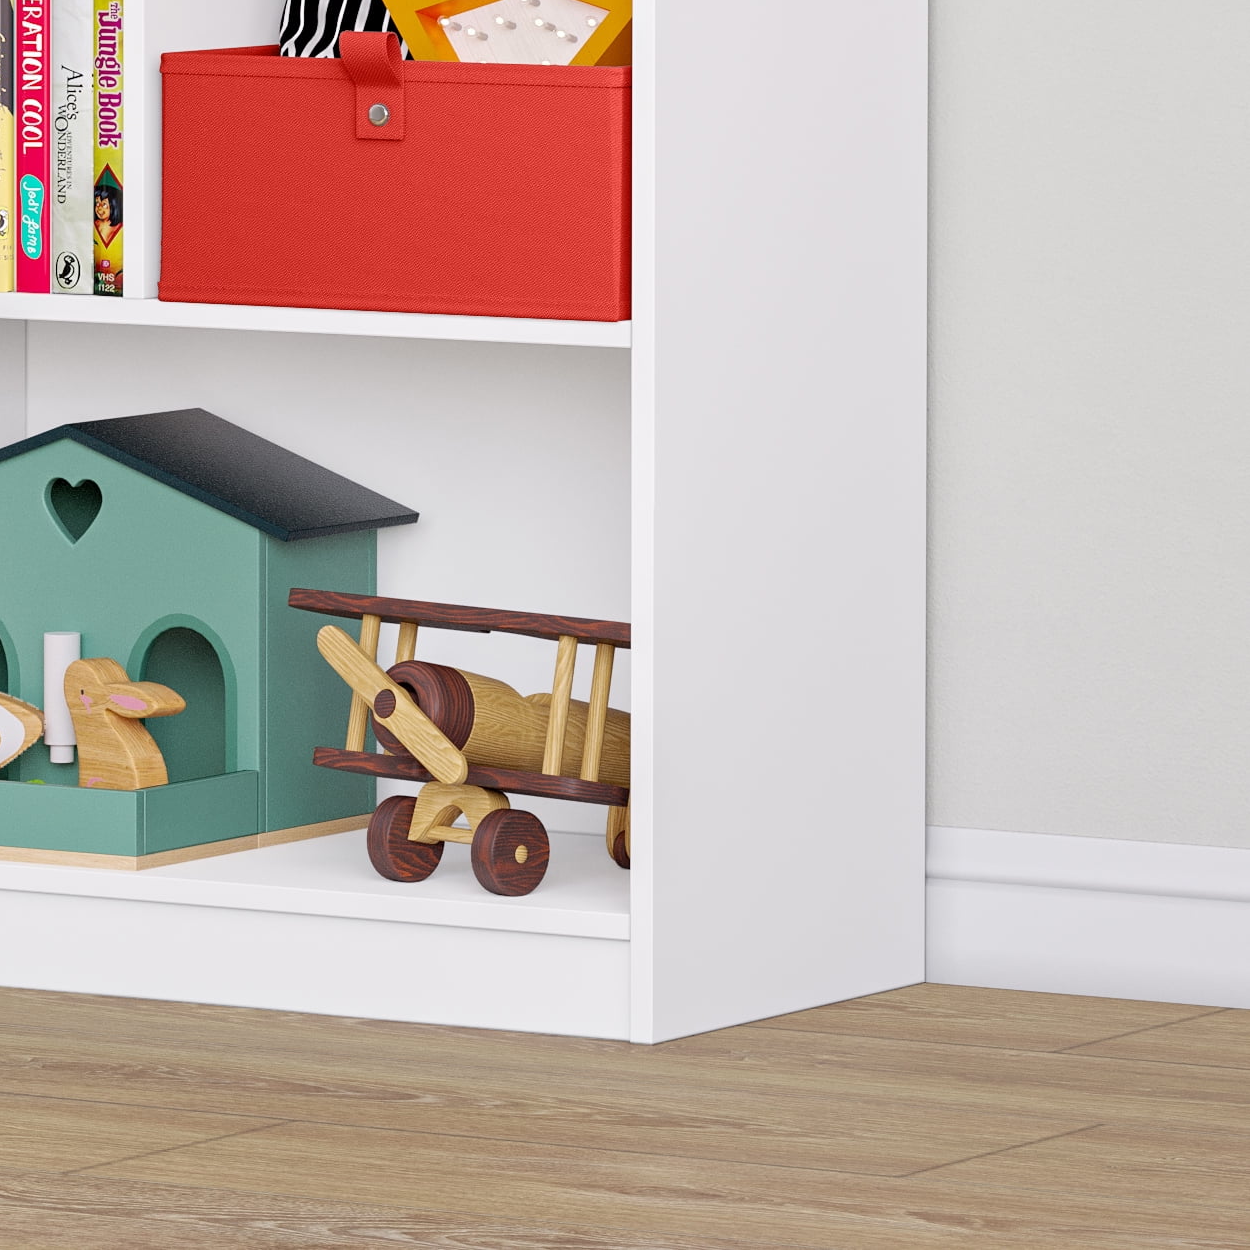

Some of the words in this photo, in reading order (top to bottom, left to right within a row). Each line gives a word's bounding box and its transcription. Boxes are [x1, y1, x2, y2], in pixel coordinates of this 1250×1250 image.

[110, 2, 120, 19] The
[95, 12, 121, 88] Jungle
[61, 65, 84, 120] Alice's
[98, 91, 121, 148] Book
[21, 98, 44, 155] COOL
[54, 104, 69, 204] WONDERLAND
[97, 272, 115, 282] VHS
[98, 283, 116, 293] 1122
